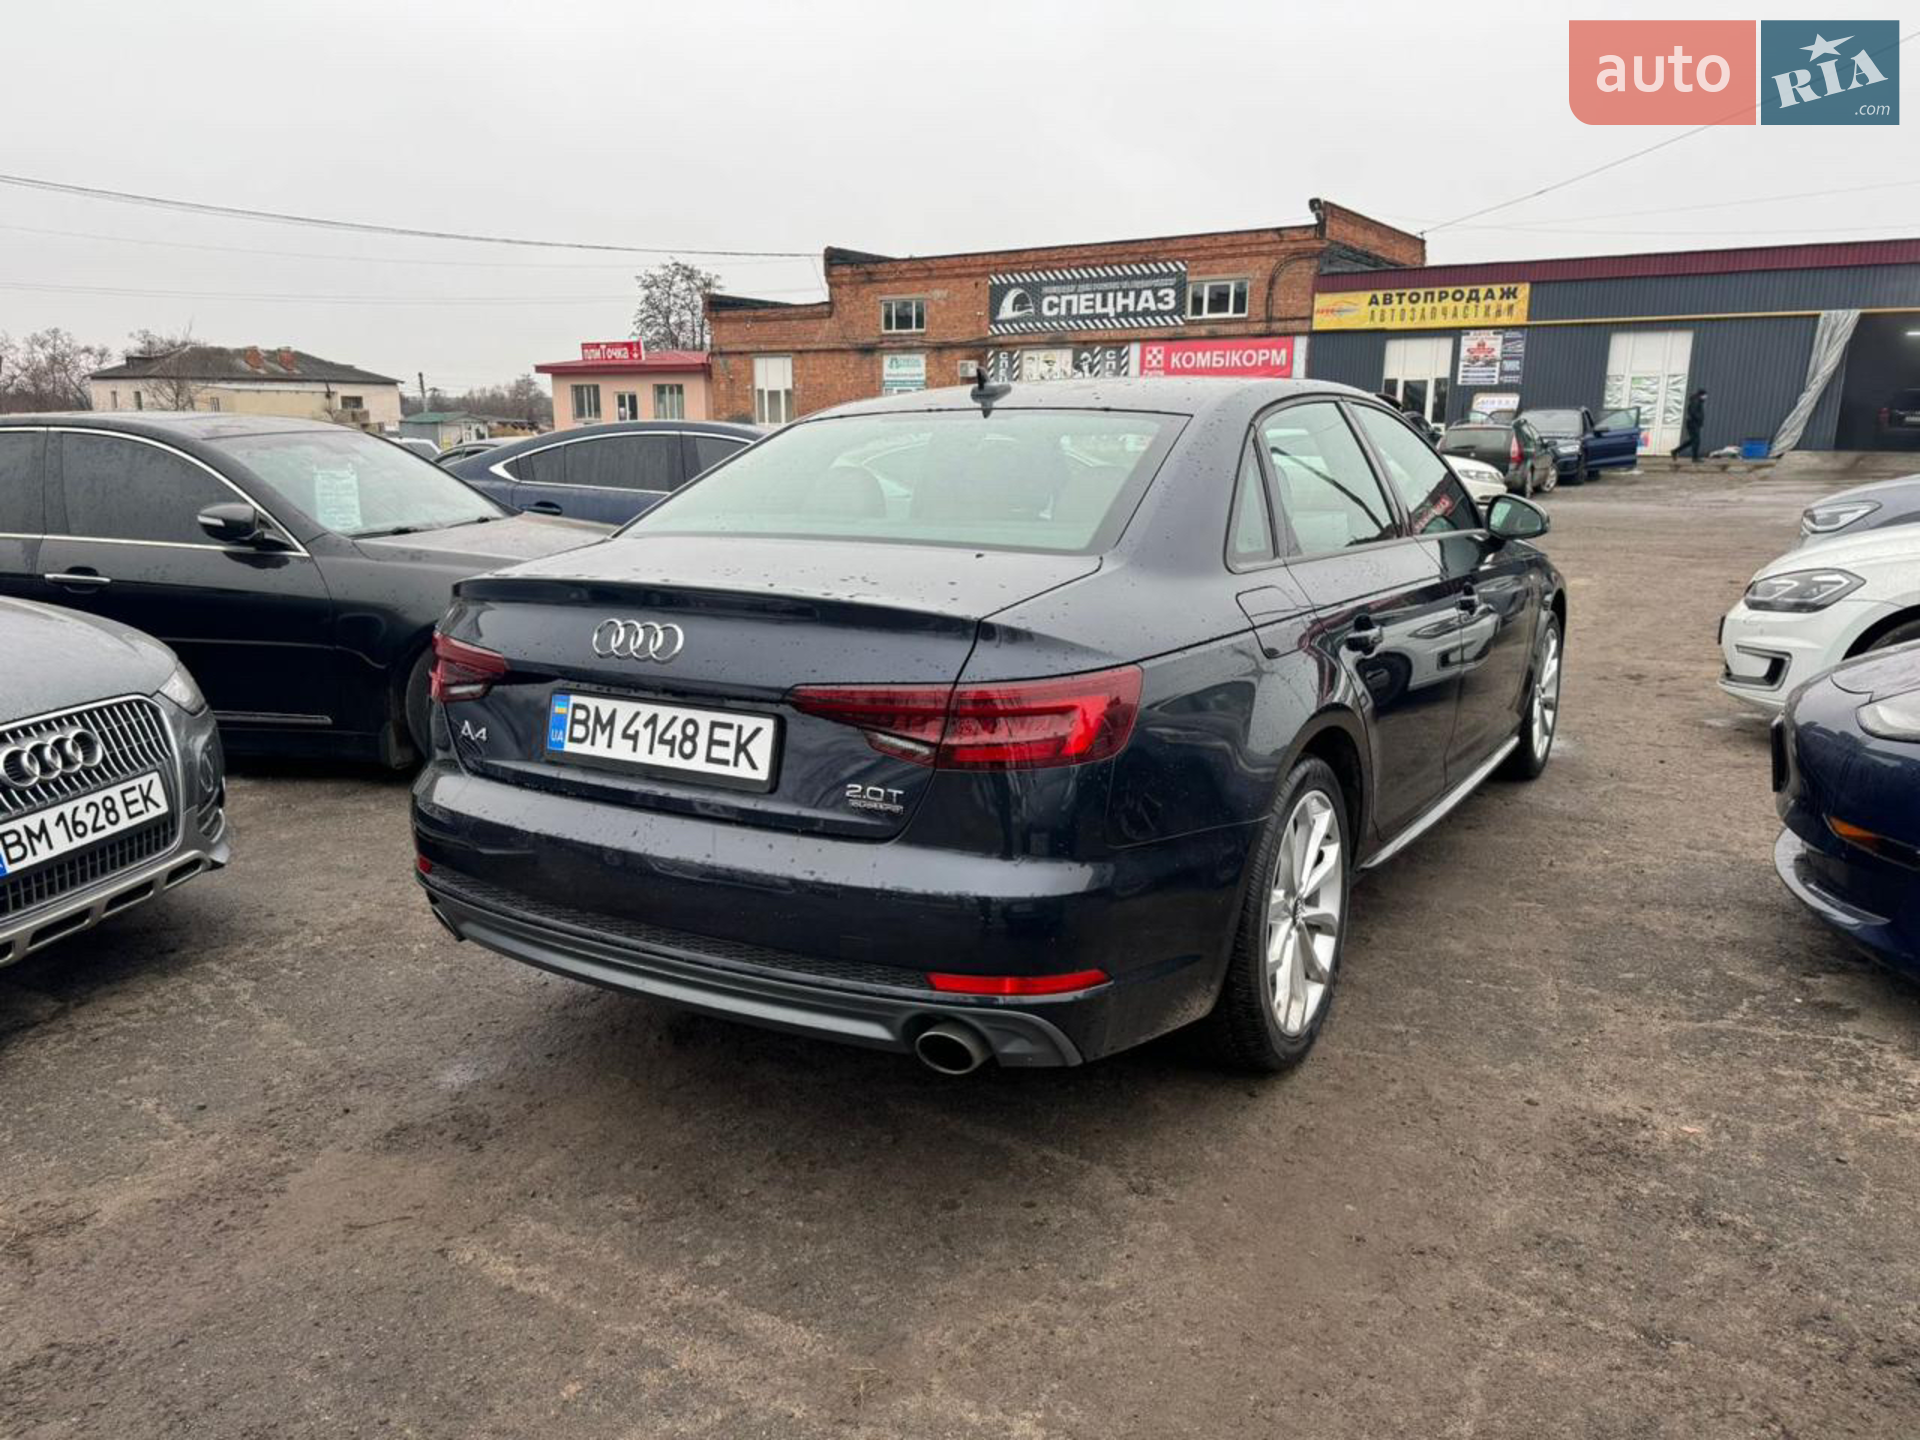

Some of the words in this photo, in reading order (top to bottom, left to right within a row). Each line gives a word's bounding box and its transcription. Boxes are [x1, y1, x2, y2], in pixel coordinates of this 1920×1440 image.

[1041, 288, 1177, 317] СПЕЦНАЗ
[1368, 286, 1519, 306] АВТОПРОДАЖ
[1170, 348, 1287, 369] КОМБІКОРМ
[460, 720, 488, 741] A4
[621, 710, 701, 760] 4148
[55, 795, 121, 843] 1628
